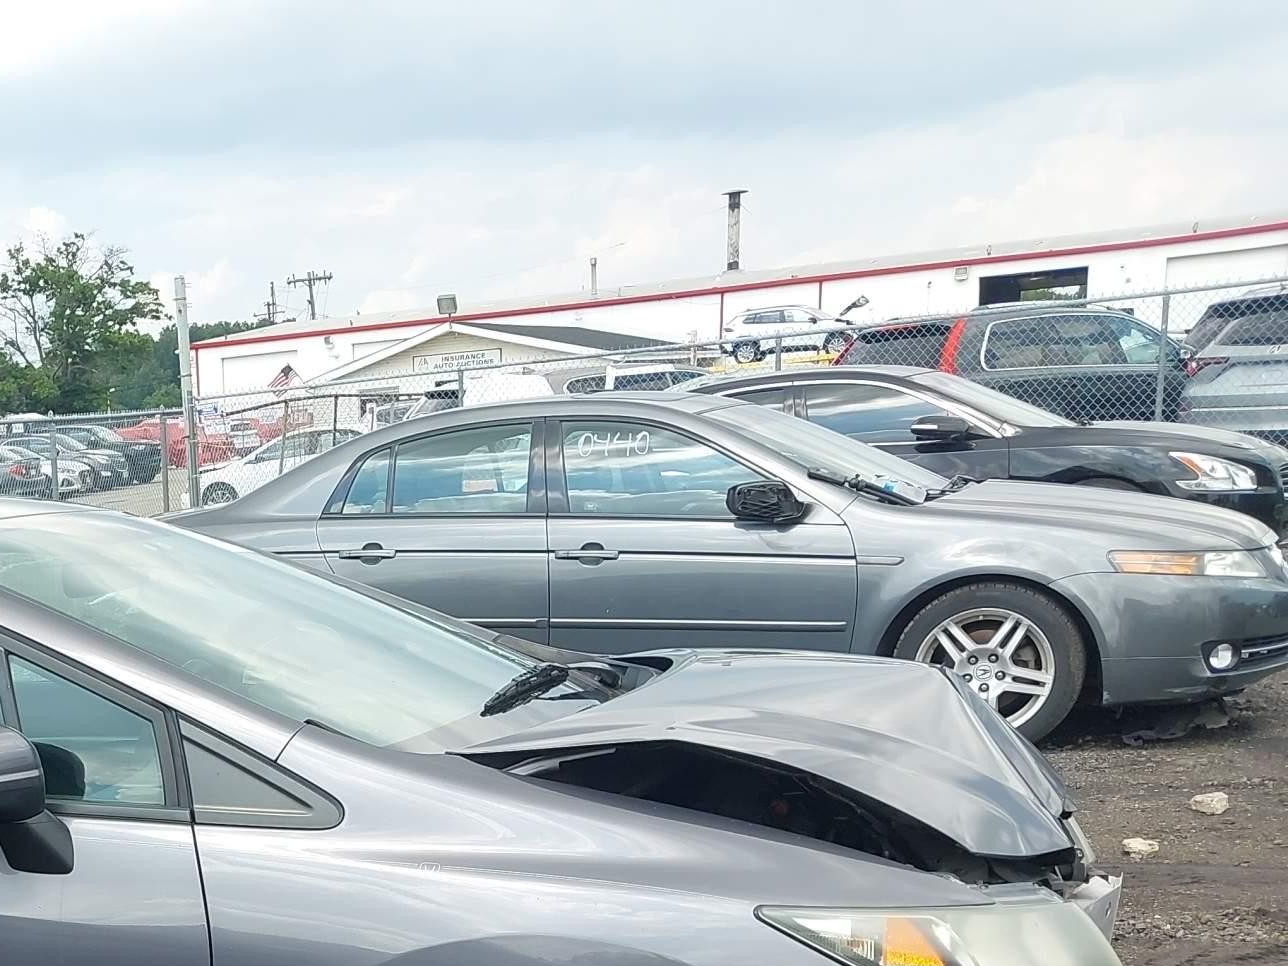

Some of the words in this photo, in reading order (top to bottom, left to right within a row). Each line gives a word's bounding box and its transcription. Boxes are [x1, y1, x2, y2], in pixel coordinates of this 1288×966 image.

[441, 352, 486, 362] INSURANCE
[434, 362, 454, 370] AUTO
[456, 358, 495, 368] AUCTIONS
